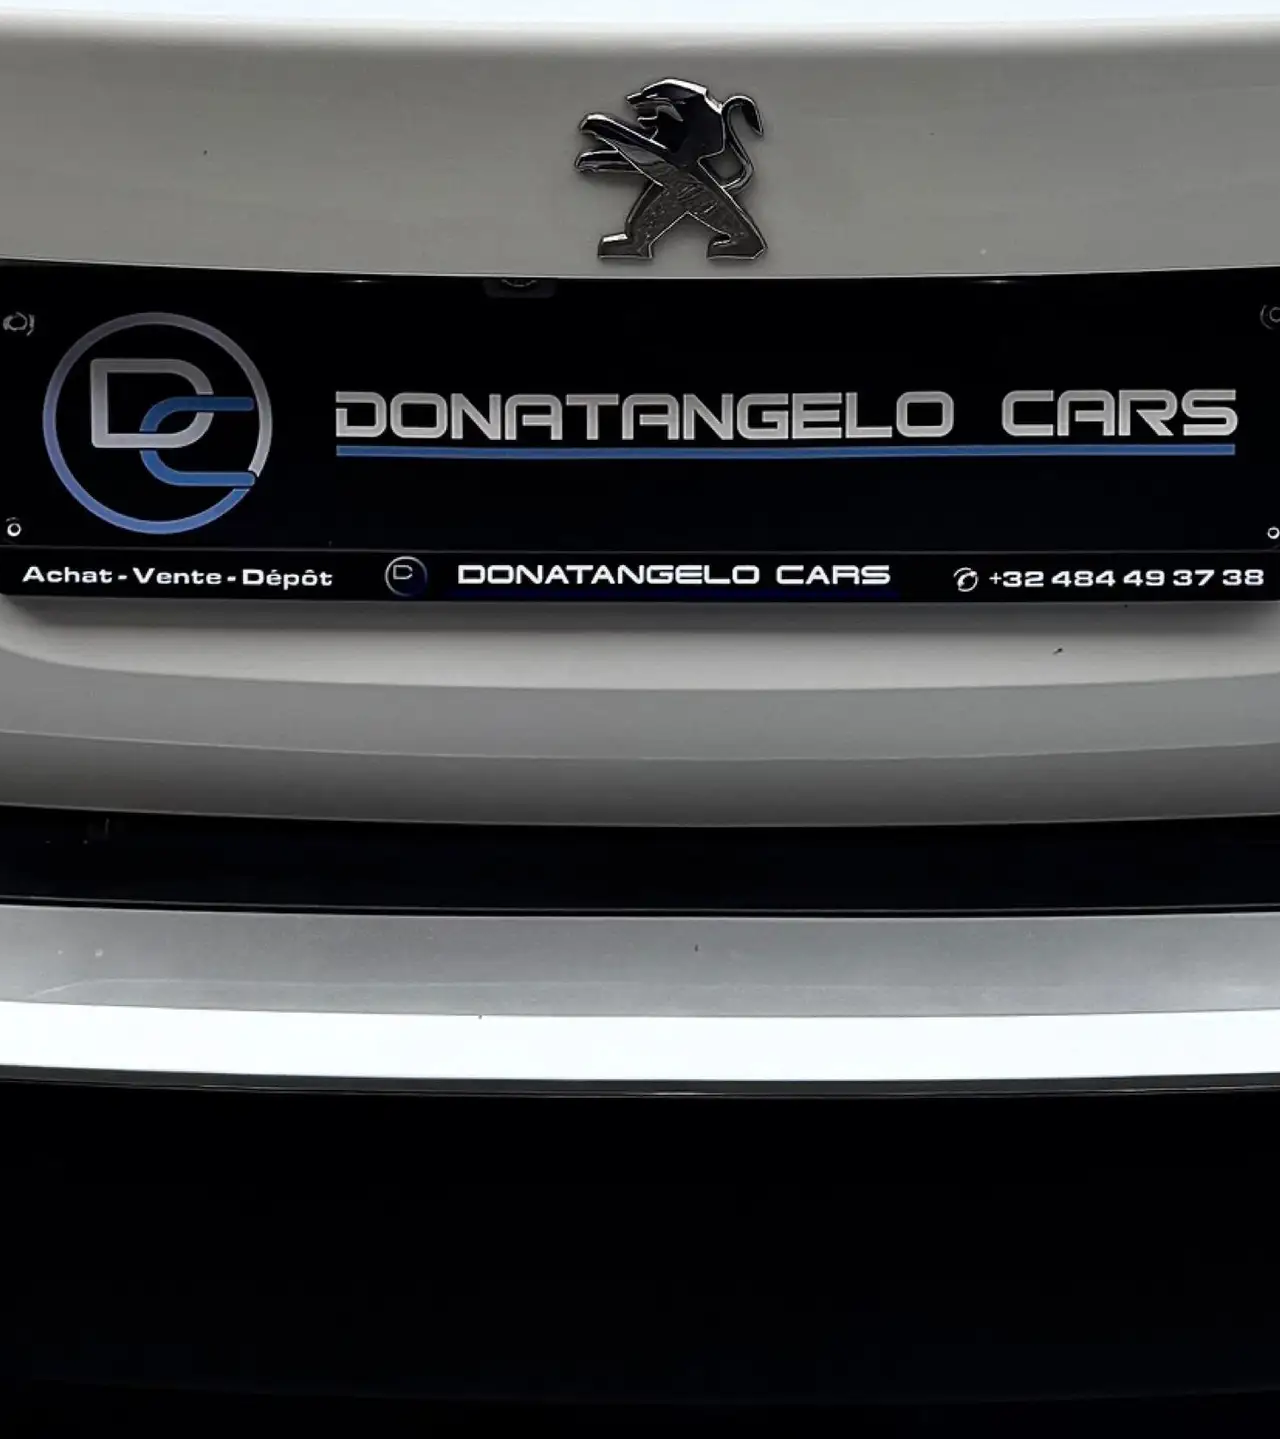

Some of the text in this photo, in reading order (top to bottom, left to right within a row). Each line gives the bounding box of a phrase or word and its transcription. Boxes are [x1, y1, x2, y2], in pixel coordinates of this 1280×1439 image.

[335, 389, 1239, 441] DONATANGELO CARS
[457, 563, 891, 585] DONATANGELO CARS
[987, 568, 1265, 588] +32 484 49 37 38
